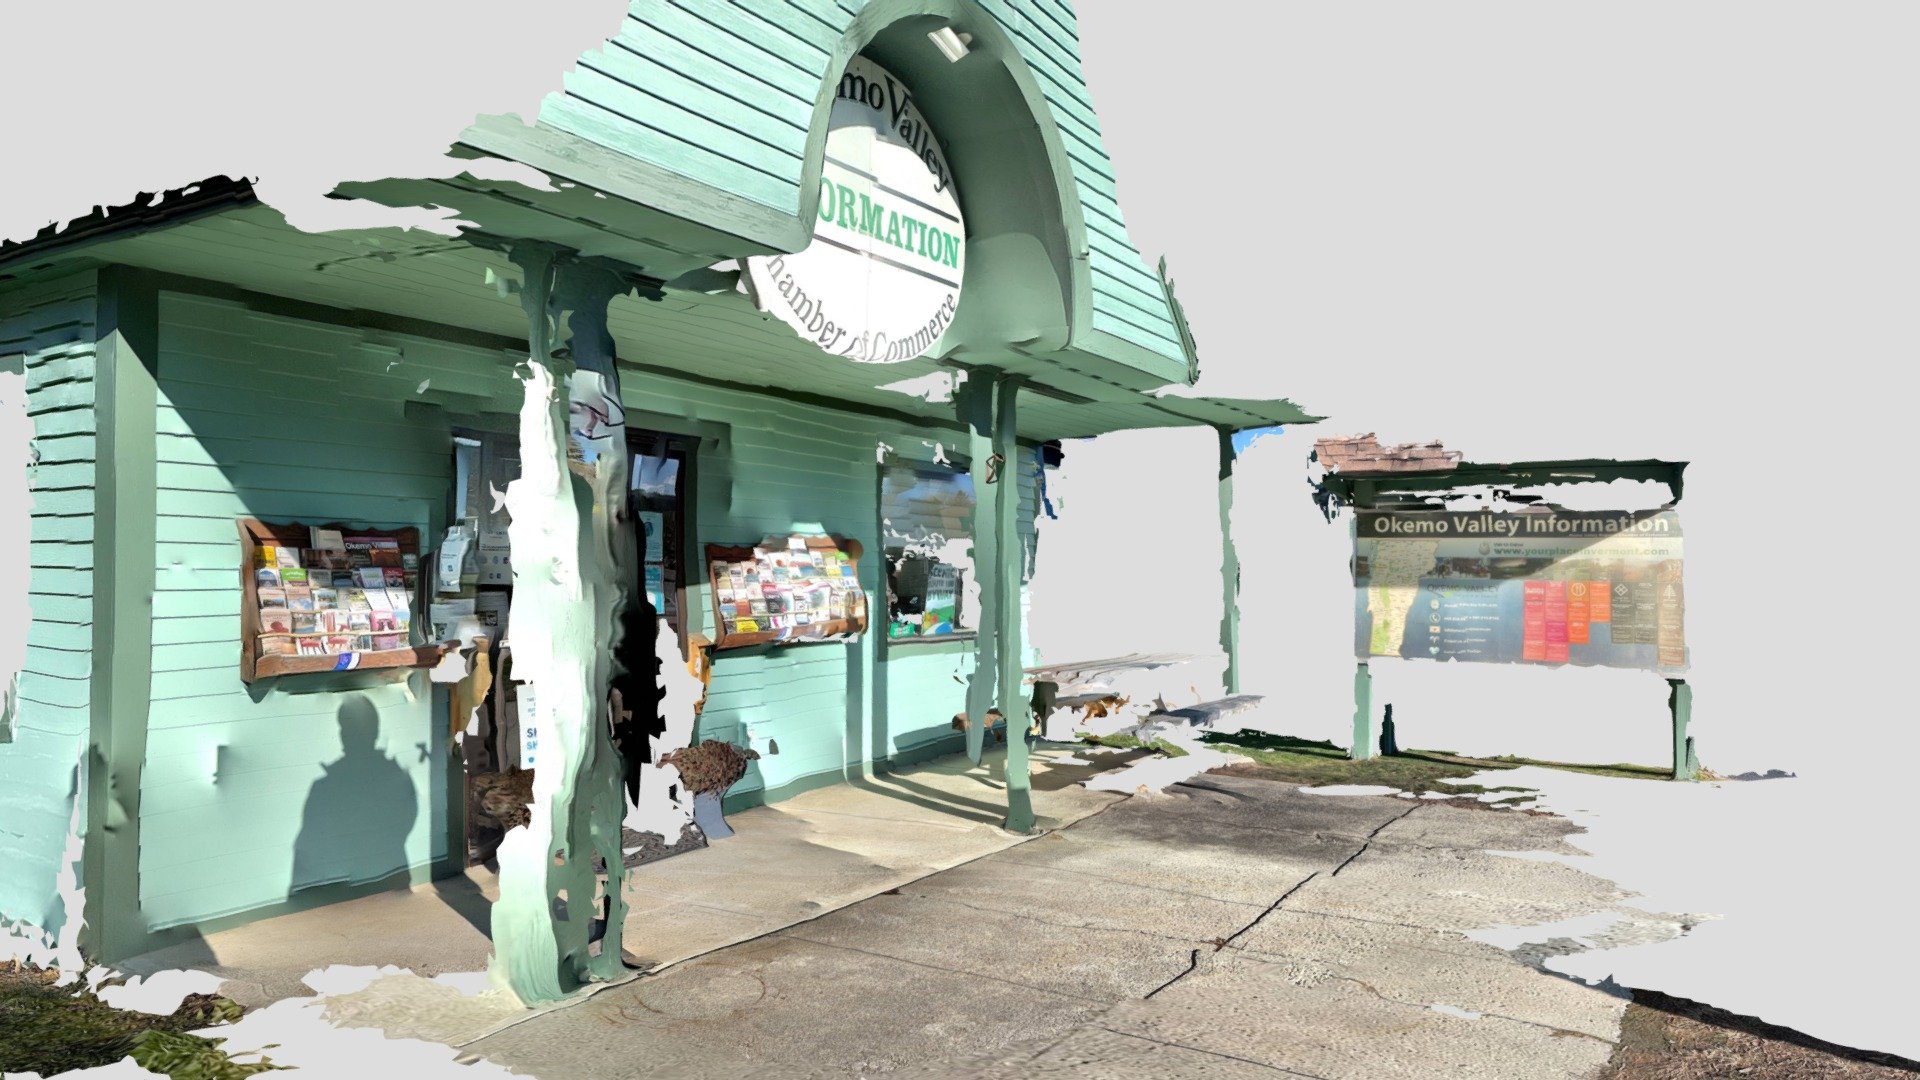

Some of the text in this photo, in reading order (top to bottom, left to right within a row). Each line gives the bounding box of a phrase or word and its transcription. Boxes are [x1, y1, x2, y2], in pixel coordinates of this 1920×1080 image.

[884, 74, 949, 193] Valley
[818, 176, 960, 269] ORMATION
[868, 293, 955, 362] Commerce
[1374, 514, 1669, 537] Okemo Valley Information
